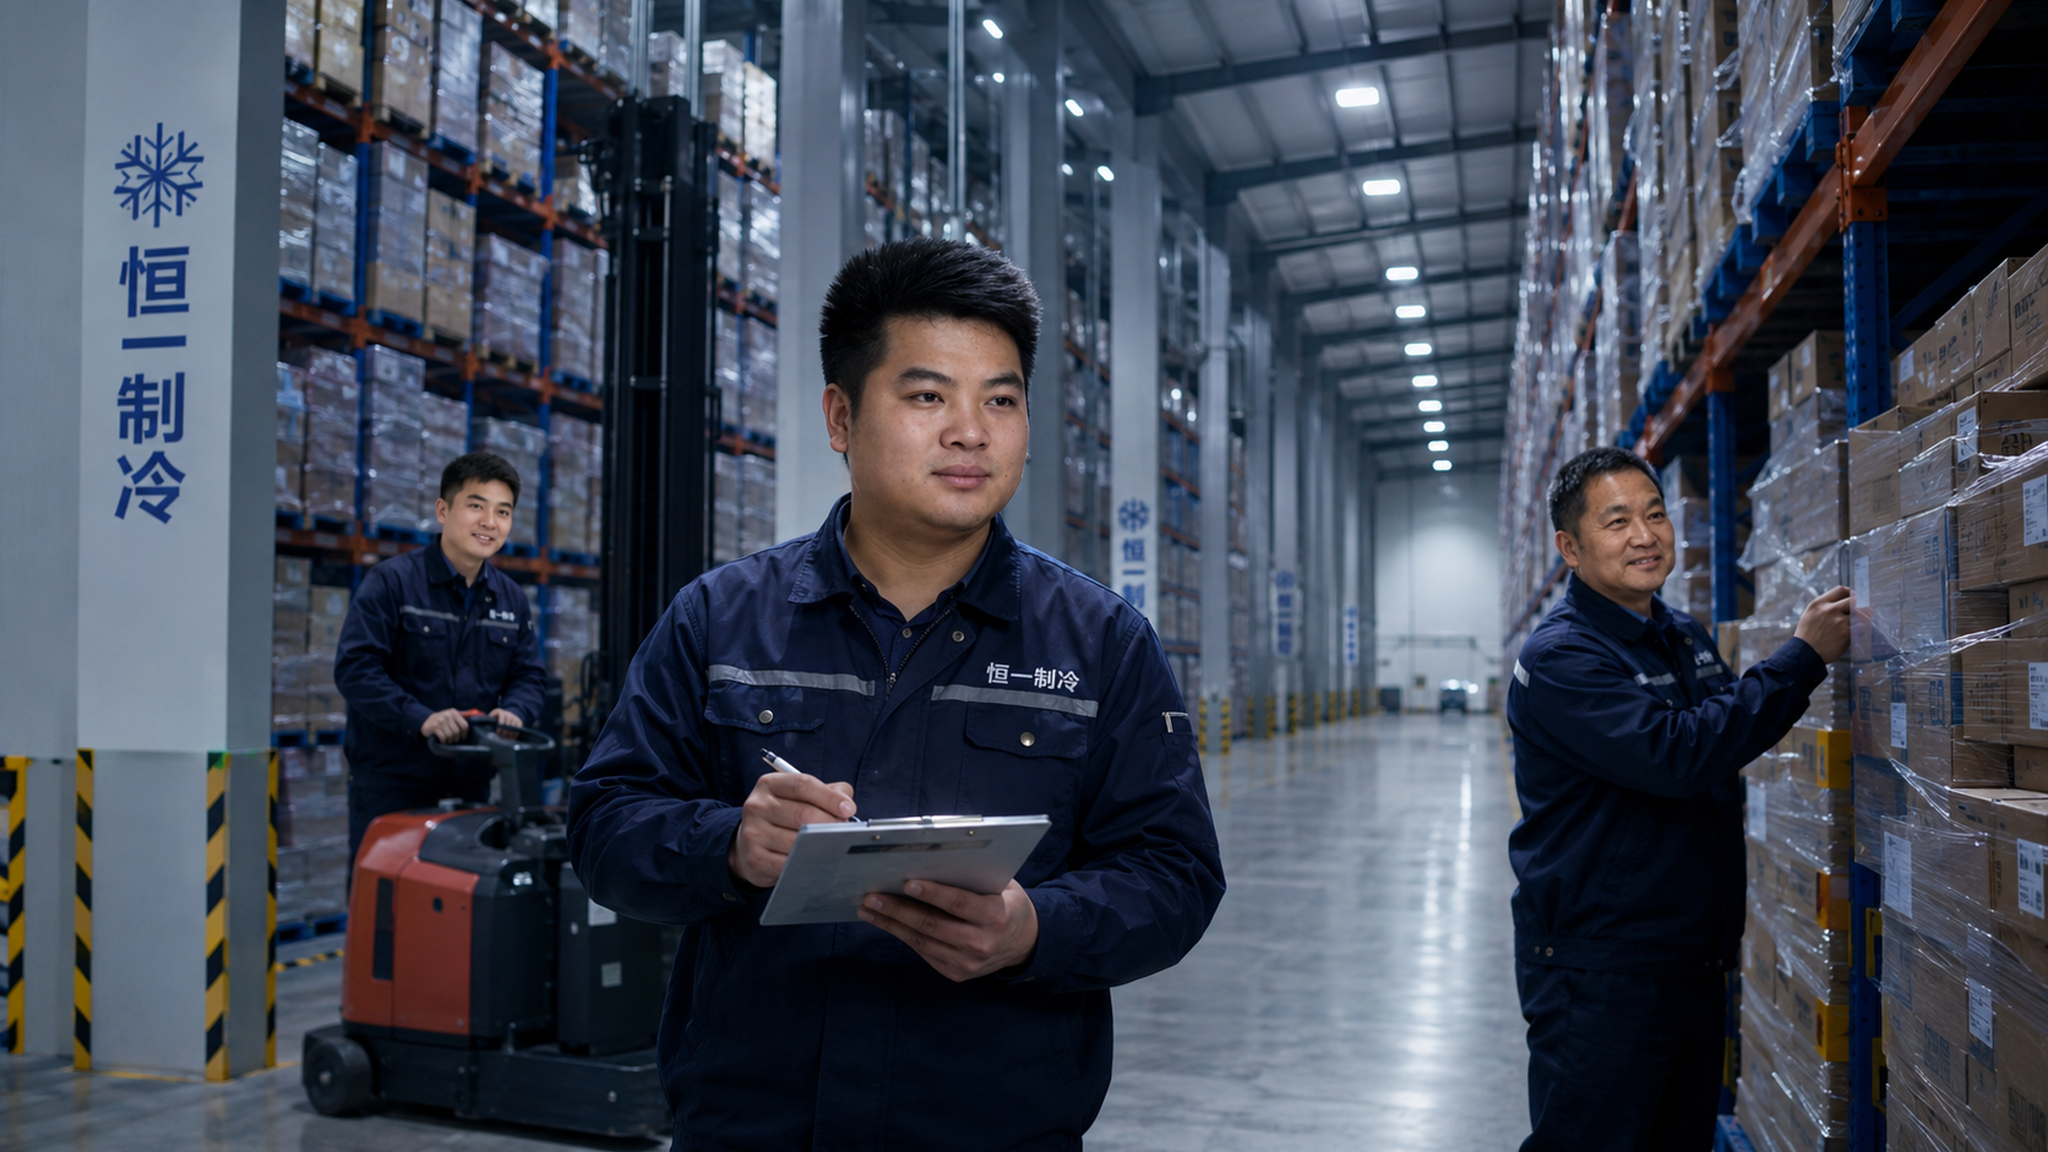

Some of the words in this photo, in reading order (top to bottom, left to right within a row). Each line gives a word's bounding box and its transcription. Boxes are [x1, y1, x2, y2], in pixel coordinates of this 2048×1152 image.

[114, 245, 190, 525] 恒一制冷
[986, 661, 1080, 693] 恒一制冷
